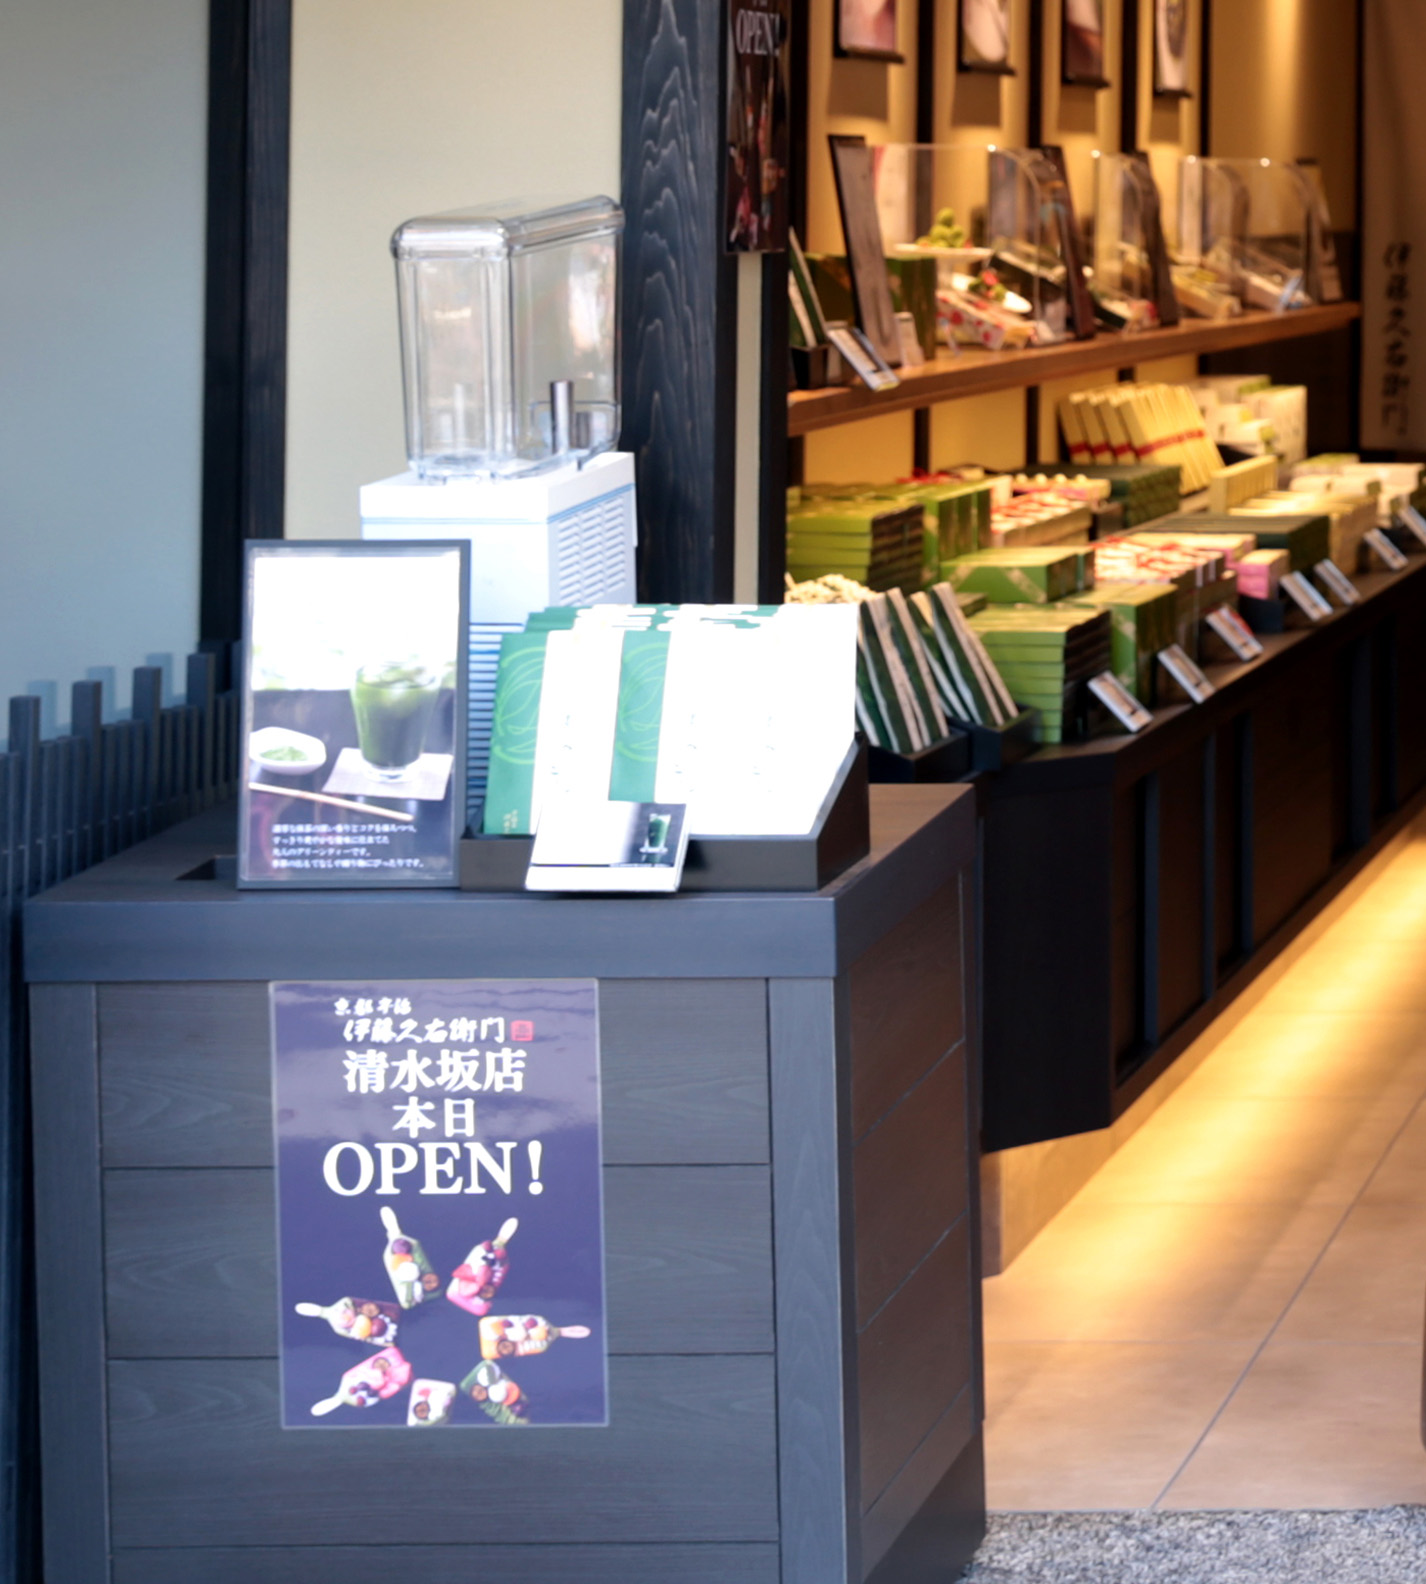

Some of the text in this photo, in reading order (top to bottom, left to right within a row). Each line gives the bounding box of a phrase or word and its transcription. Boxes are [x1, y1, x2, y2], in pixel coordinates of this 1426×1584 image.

[735, 8, 780, 57] OPEN!
[344, 1017, 504, 1043] 伊藤久右衛門
[343, 1048, 526, 1093] 清水坂店
[393, 1096, 474, 1138] 本日
[324, 1141, 542, 1195] OPEN!
